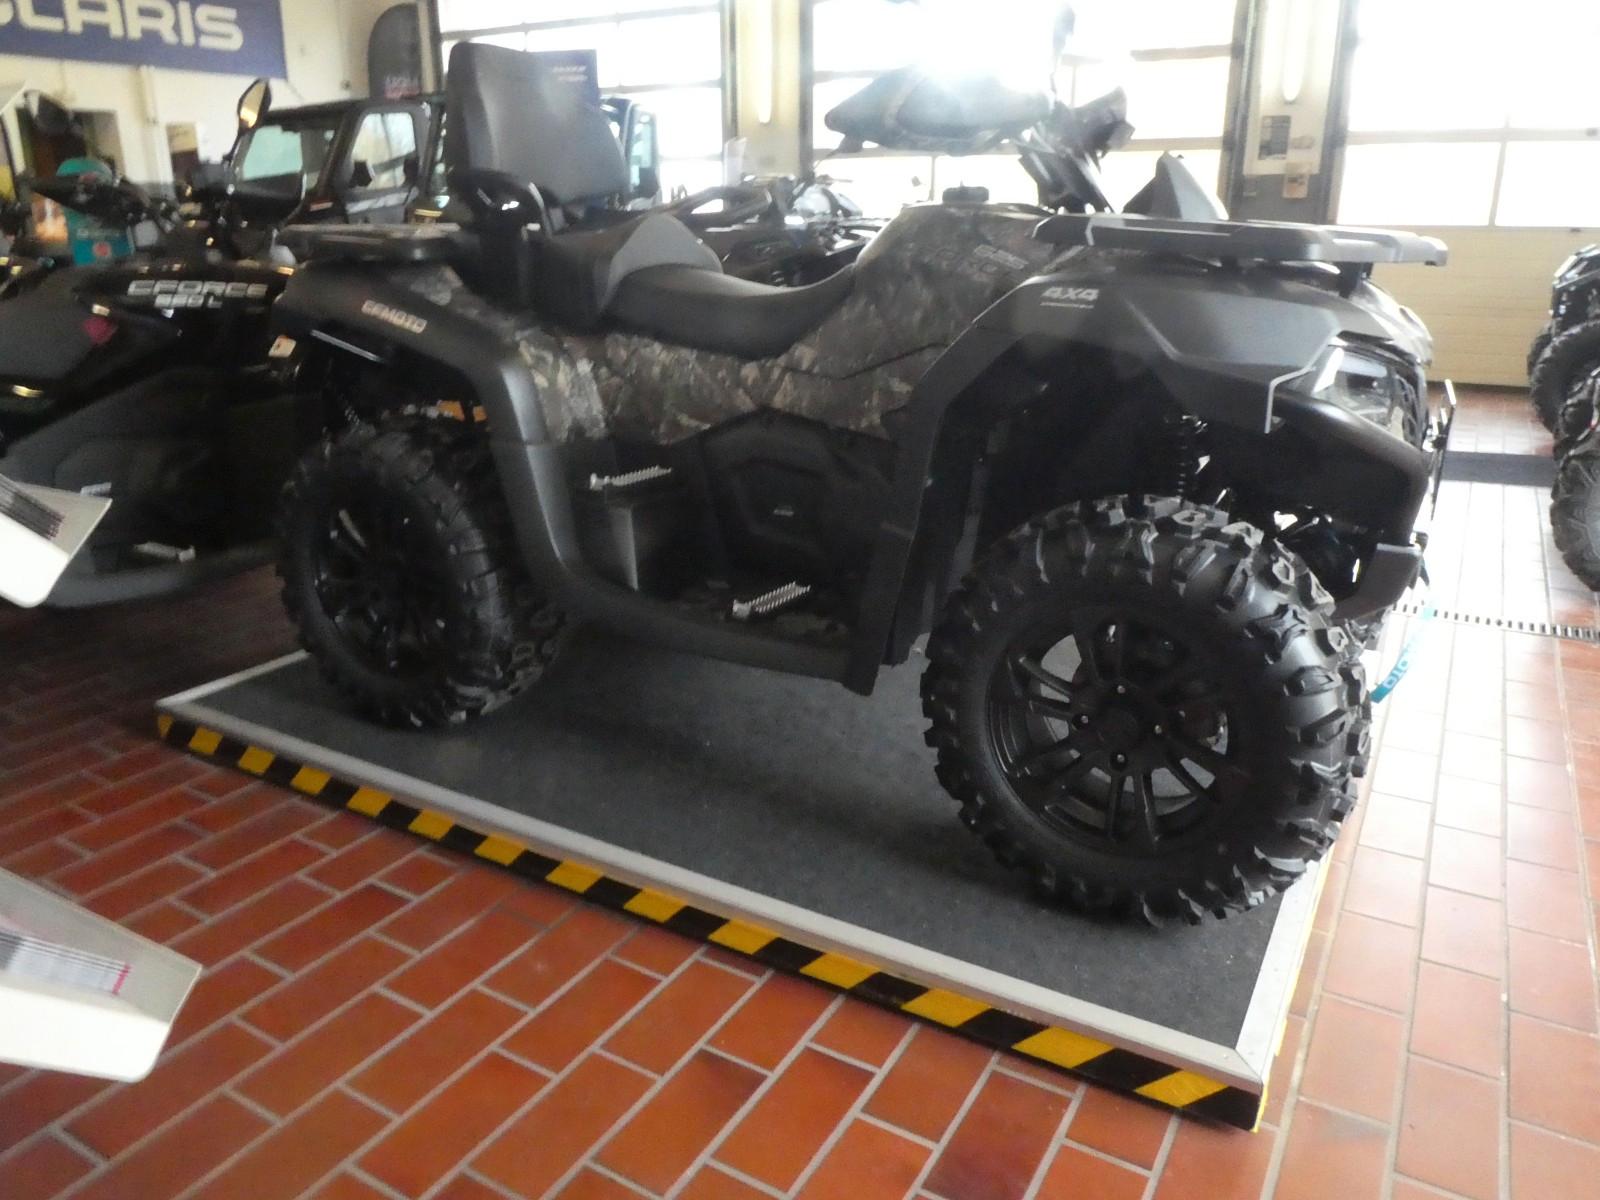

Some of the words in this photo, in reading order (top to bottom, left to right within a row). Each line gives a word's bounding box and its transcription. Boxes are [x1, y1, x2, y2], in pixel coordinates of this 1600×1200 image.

[0, 0, 243, 51] LARIS
[1041, 286, 1099, 301] 4X4
[361, 300, 427, 333] CFMOTO
